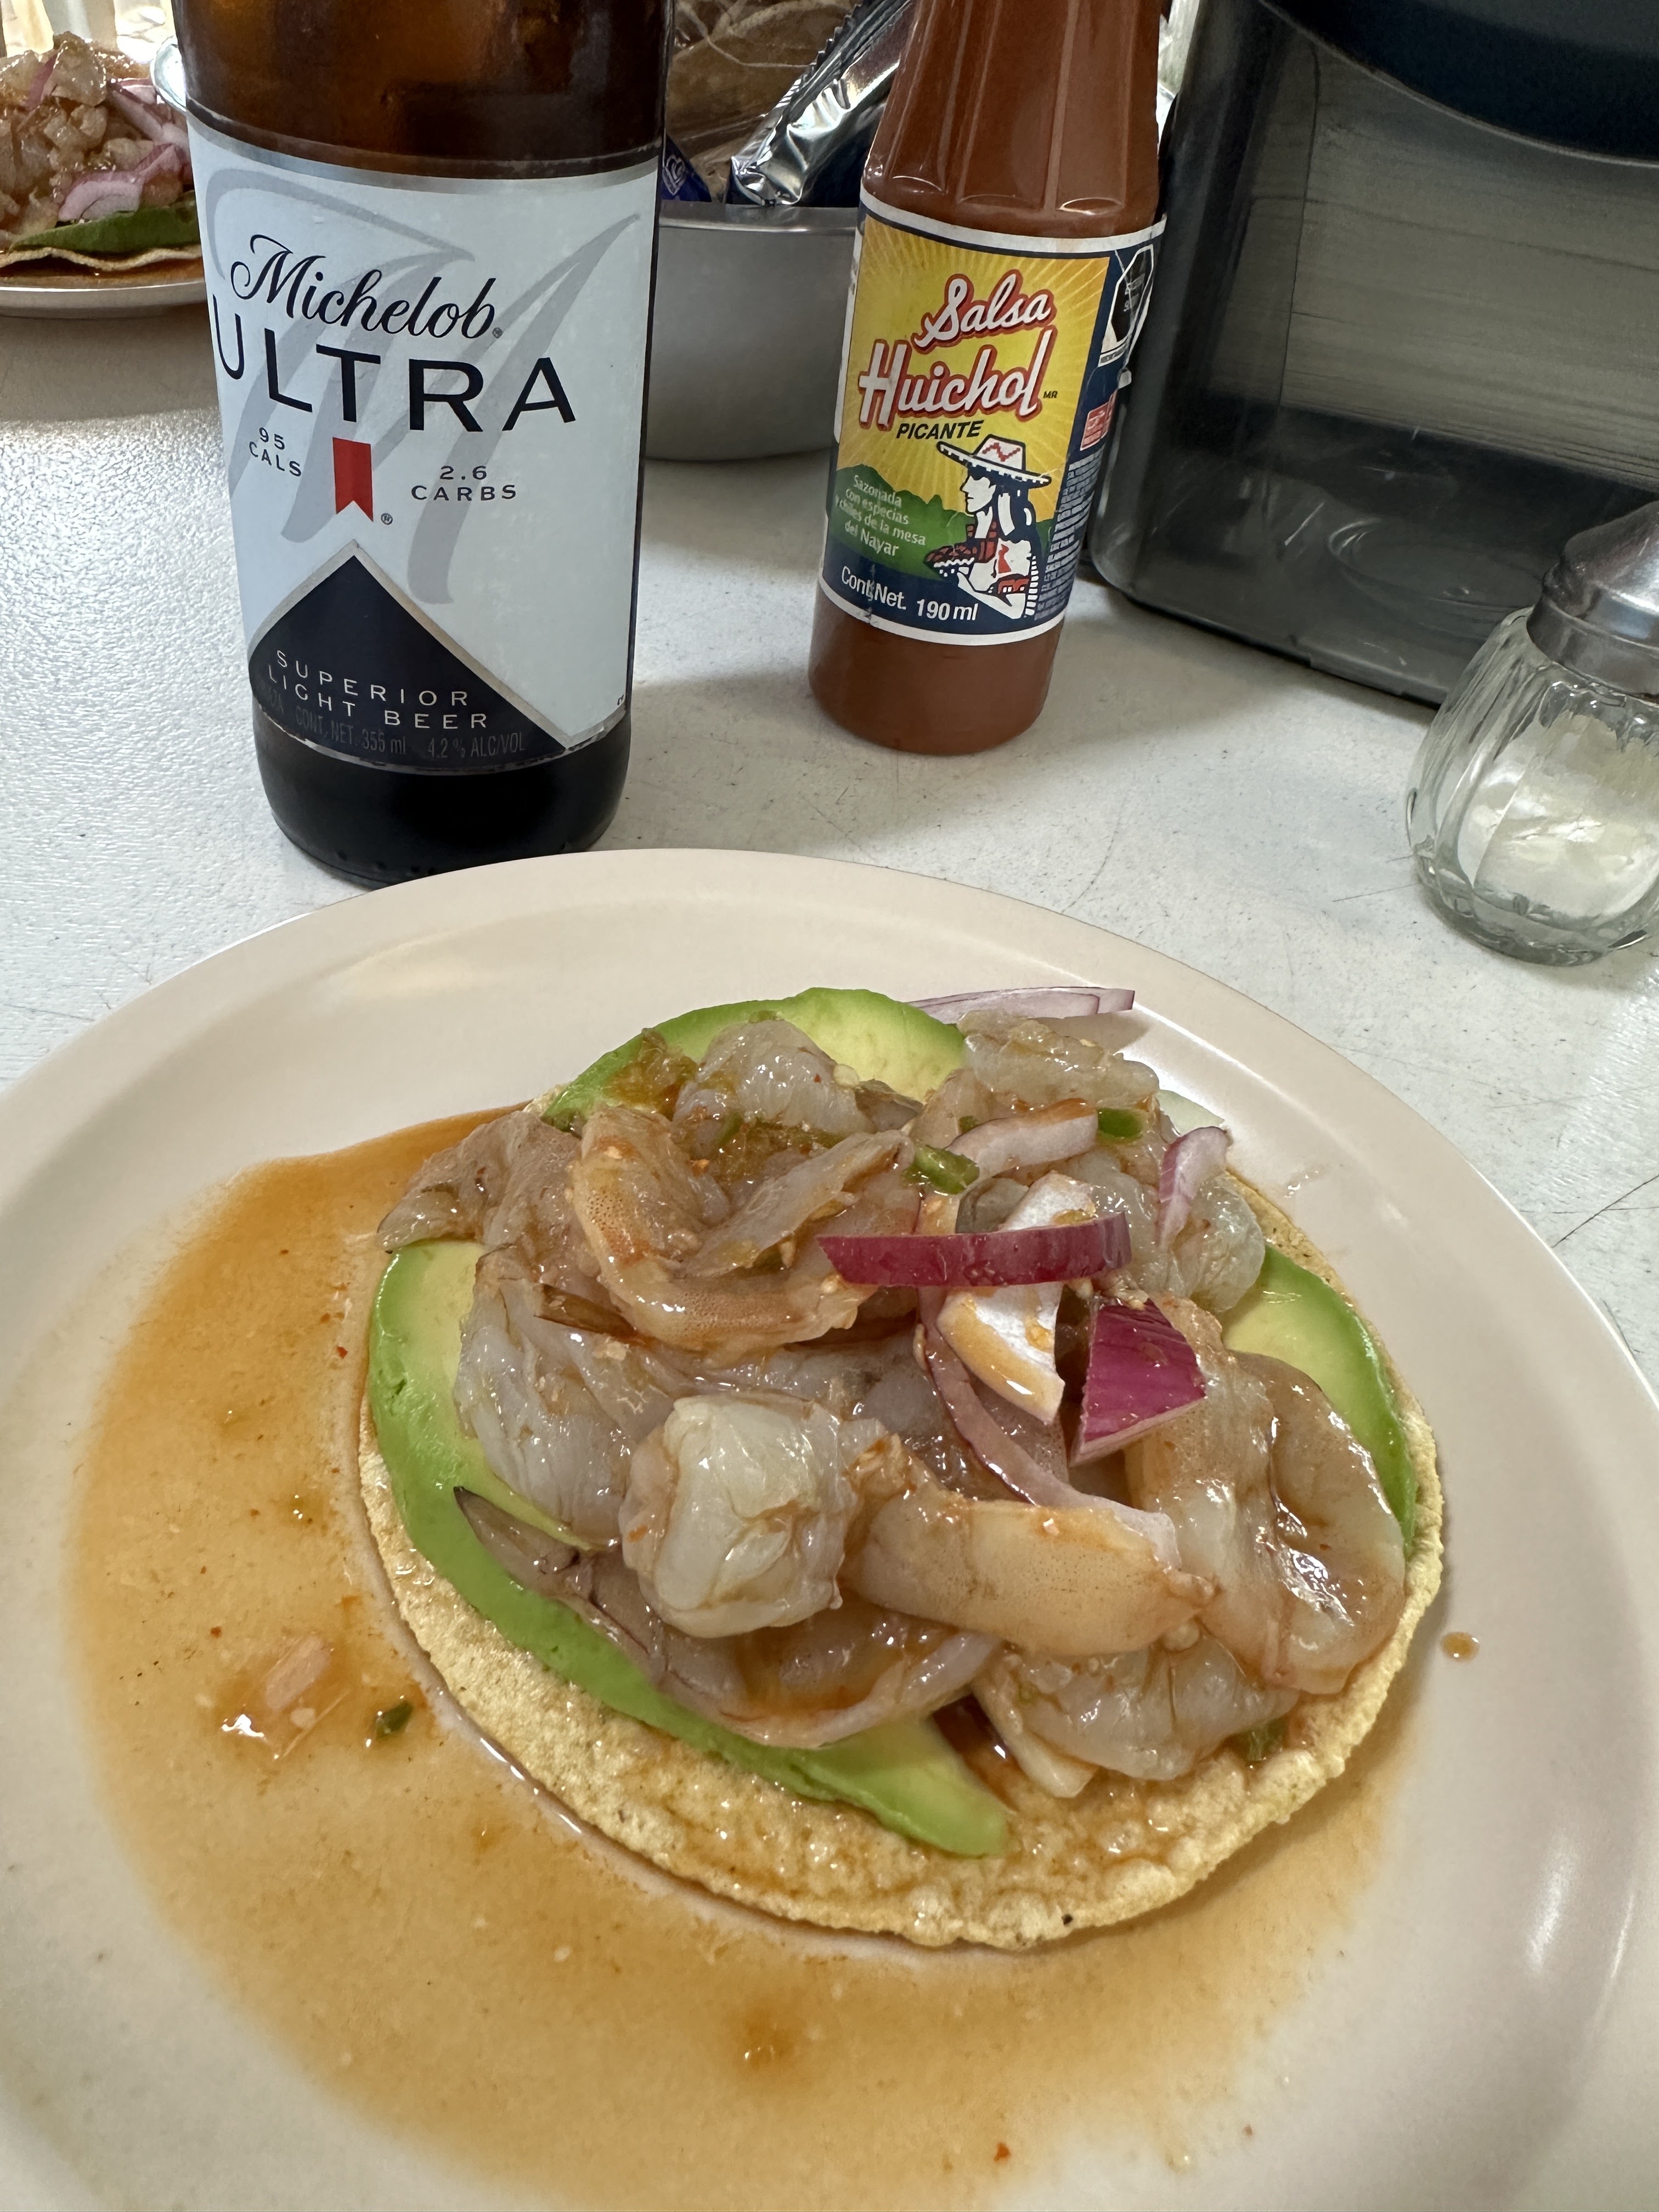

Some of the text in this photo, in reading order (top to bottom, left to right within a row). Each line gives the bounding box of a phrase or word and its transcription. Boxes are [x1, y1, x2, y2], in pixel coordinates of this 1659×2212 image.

[231, 234, 496, 339] Michelob
[913, 272, 1053, 349] Salsa
[213, 295, 576, 432] ULTRA
[858, 328, 1054, 430] Huichol
[1043, 391, 1058, 399] MR
[258, 427, 285, 450] 95
[896, 420, 985, 439] PICANTE
[249, 443, 302, 477] CALS
[440, 466, 487, 481] 2.6
[411, 485, 516, 501] CARBS
[860, 528, 899, 556] Nayar
[893, 527, 926, 545] mesa
[874, 583, 906, 610] Net.
[917, 599, 950, 620] 190
[953, 603, 978, 620] ml
[276, 650, 467, 707] SUPERIOR
[269, 664, 356, 716] LIGHT
[385, 710, 486, 729] BEER
